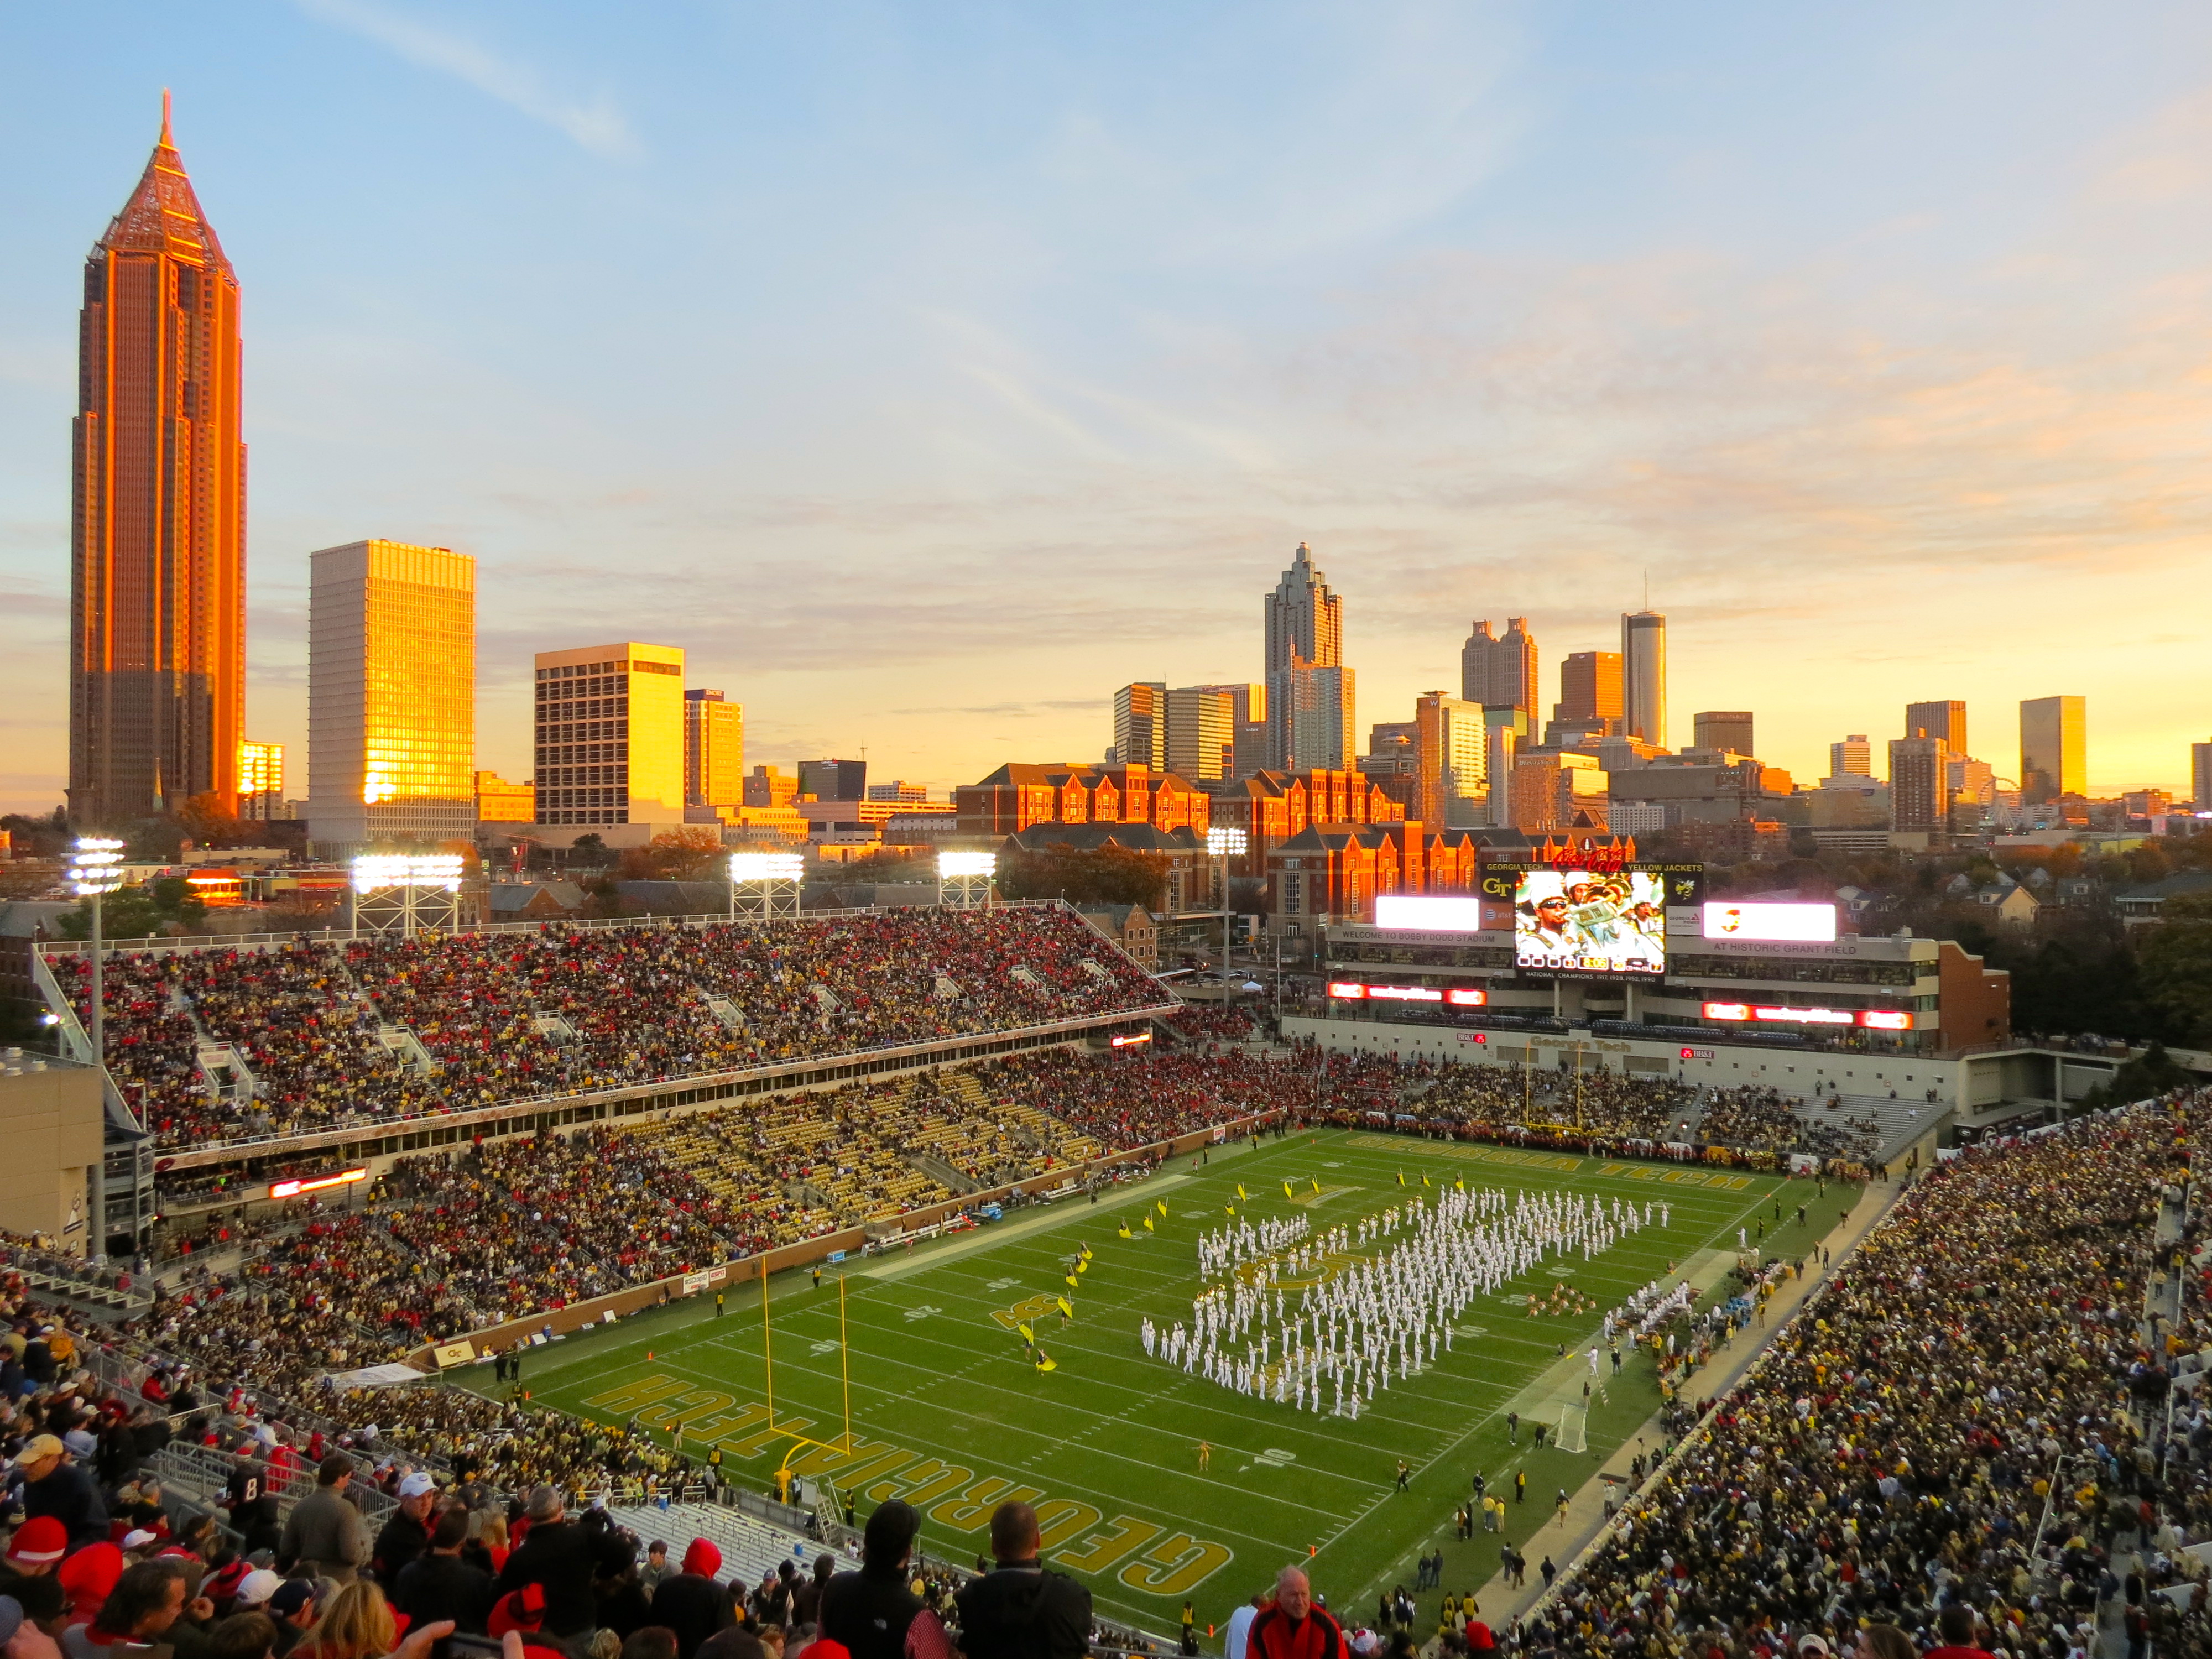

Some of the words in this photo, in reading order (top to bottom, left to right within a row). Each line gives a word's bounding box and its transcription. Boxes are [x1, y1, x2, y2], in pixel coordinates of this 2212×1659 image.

[1552, 848, 1624, 872] Coca-Cola
[1483, 878, 1511, 897] GT
[1498, 910, 1511, 919] at&t
[1343, 931, 1383, 939] WELCOME
[1399, 932, 1427, 941] BOBBY
[1430, 933, 1454, 941] DODD
[1457, 935, 1495, 943] STADIUM
[1714, 942, 1726, 951] AT
[1730, 943, 1780, 952] HISTORIC
[1783, 945, 1821, 954] GRANT
[1825, 946, 1856, 954] FIELD
[1530, 1035, 1590, 1051] Georgia
[1594, 1040, 1631, 1052] Tech
[218, 1150, 248, 1162] HALL
[250, 1147, 269, 1157] OF
[269, 1143, 304, 1155] FAME
[1346, 1135, 1584, 1172] GEORGIA
[1595, 1162, 1755, 1190] TECH
[447, 1349, 462, 1358] GT
[580, 1374, 818, 1460] TECH
[1254, 1448, 1297, 1468] 10
[246, 1477, 258, 1501] 8
[781, 1431, 1234, 1596] GEORGIA
